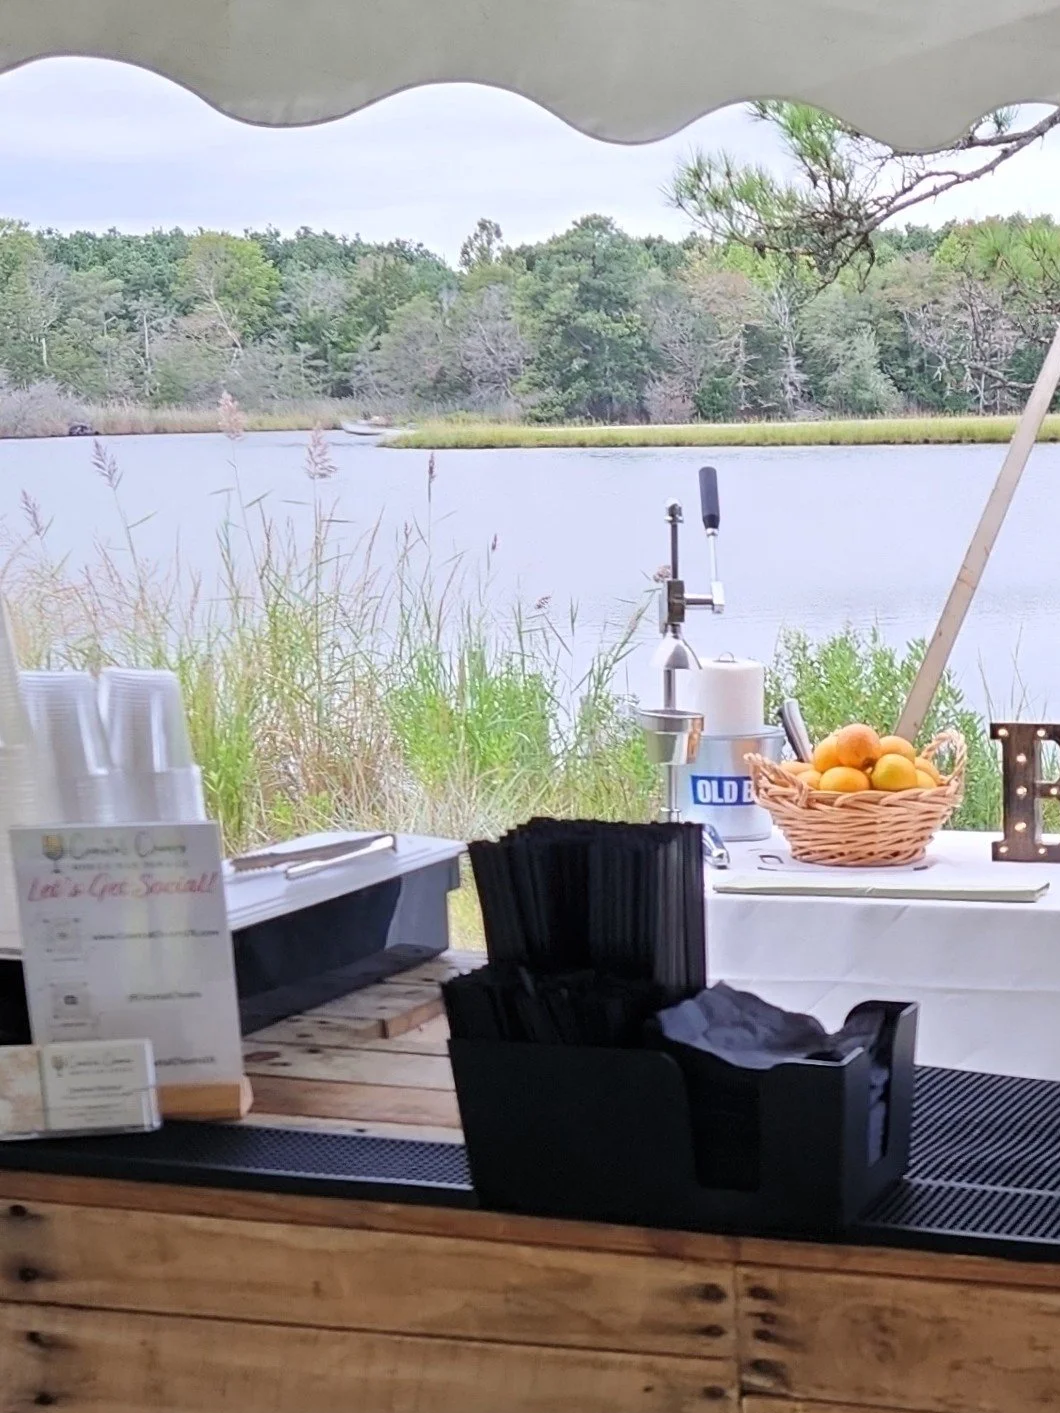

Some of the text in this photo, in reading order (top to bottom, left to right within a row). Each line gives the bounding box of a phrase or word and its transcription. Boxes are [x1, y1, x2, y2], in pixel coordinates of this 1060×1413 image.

[696, 779, 738, 803] OLD
[28, 876, 82, 902] Let's
[88, 872, 129, 902] Get
